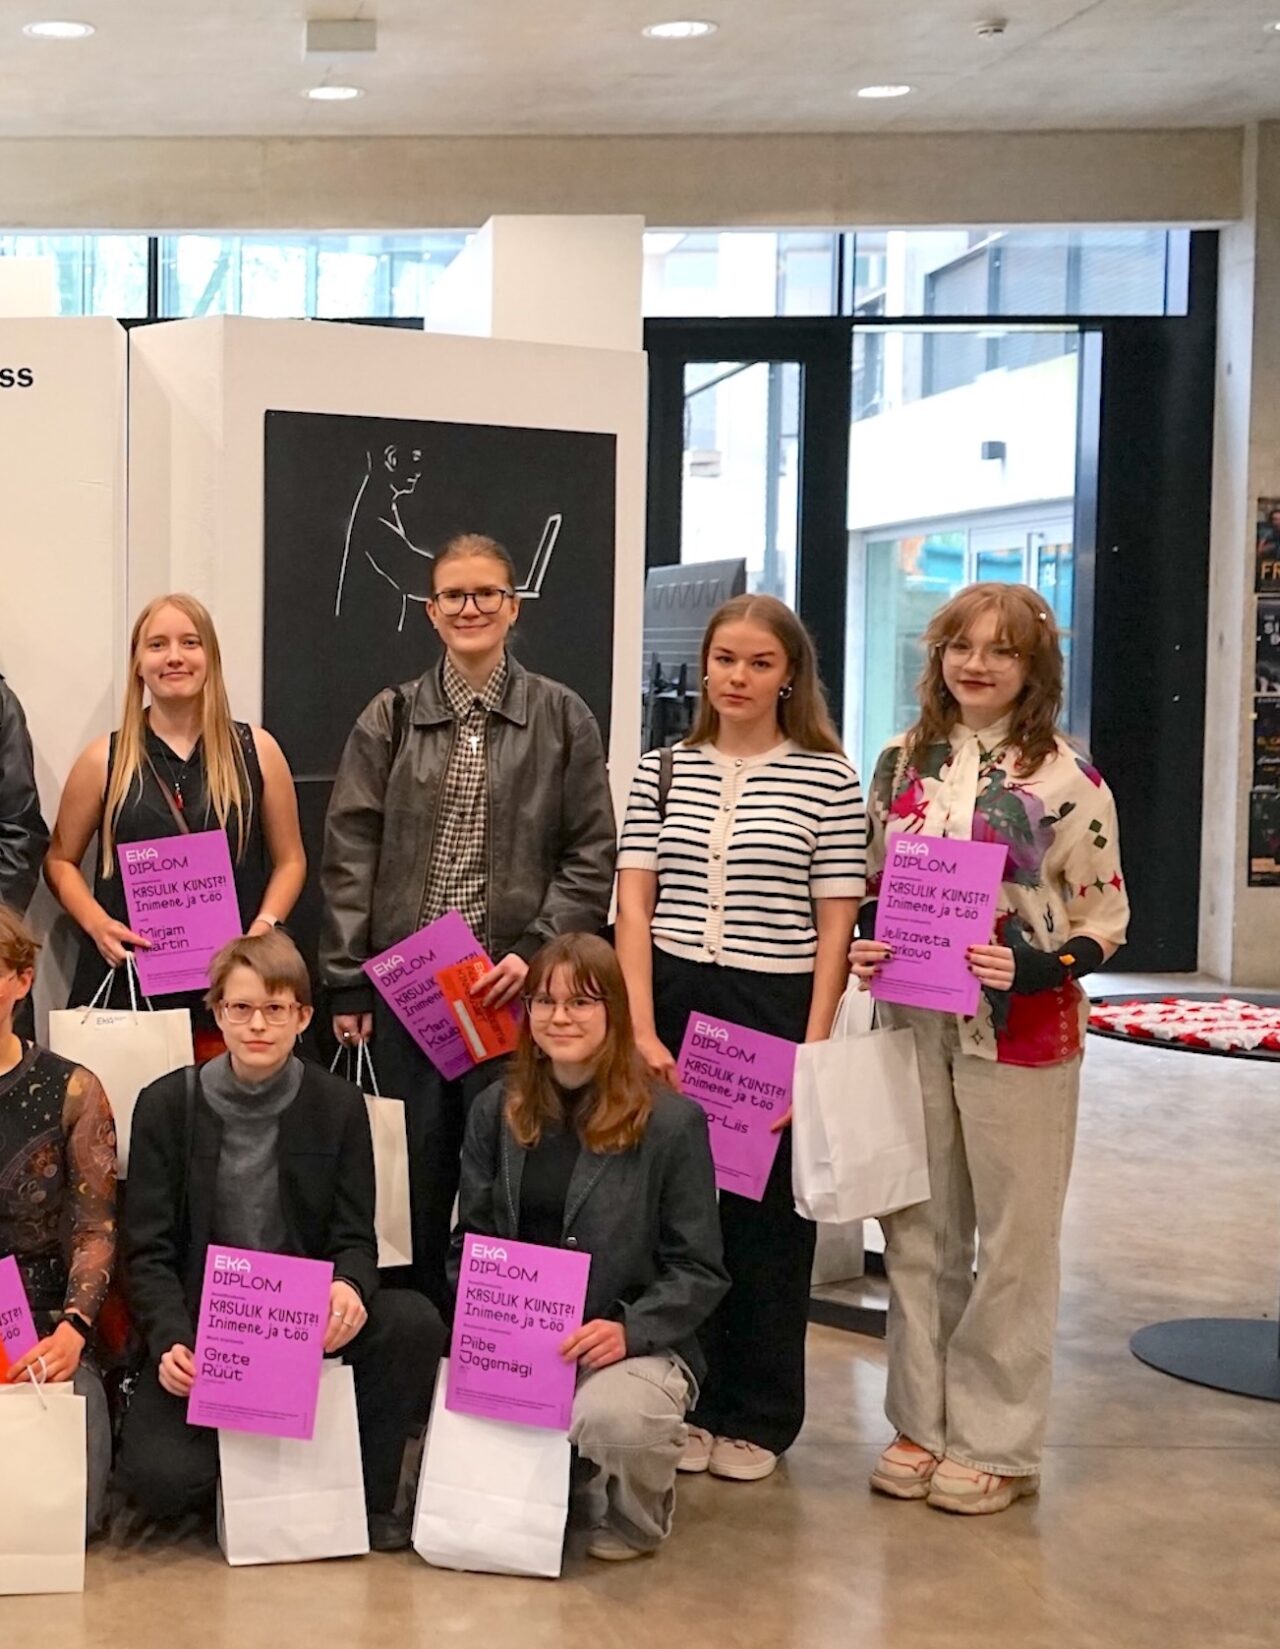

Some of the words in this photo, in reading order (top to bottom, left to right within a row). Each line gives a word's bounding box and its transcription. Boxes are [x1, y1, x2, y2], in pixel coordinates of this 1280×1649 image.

[126, 848, 158, 863] EKA
[895, 840, 929, 856] EKA
[128, 856, 188, 875] DIPLOM
[893, 855, 957, 874] DIPLOM
[136, 898, 183, 913] Inimene
[186, 895, 196, 909] ja
[886, 895, 936, 913] Inimene
[938, 904, 951, 918] ja
[140, 926, 185, 939] Mirjam
[373, 954, 405, 977] EKA
[381, 950, 436, 988] DIPLOM
[695, 1021, 729, 1041] EKA
[691, 1034, 756, 1064] DIPLOM
[682, 1072, 732, 1097] Inimene
[734, 1090, 746, 1103] ja
[705, 1112, 749, 1133] a-Liis
[471, 1243, 507, 1262] EKA
[214, 1255, 251, 1272] EKA
[470, 1260, 539, 1283] DIPLOM
[212, 1271, 282, 1293] DIPLOM
[464, 1303, 519, 1324] Inimene
[521, 1314, 534, 1329] ja
[207, 1315, 264, 1335] Inimene
[265, 1324, 278, 1339] ja
[460, 1334, 496, 1352] Piibe
[204, 1348, 250, 1366] Grete
[202, 1363, 244, 1382] Rüüt
